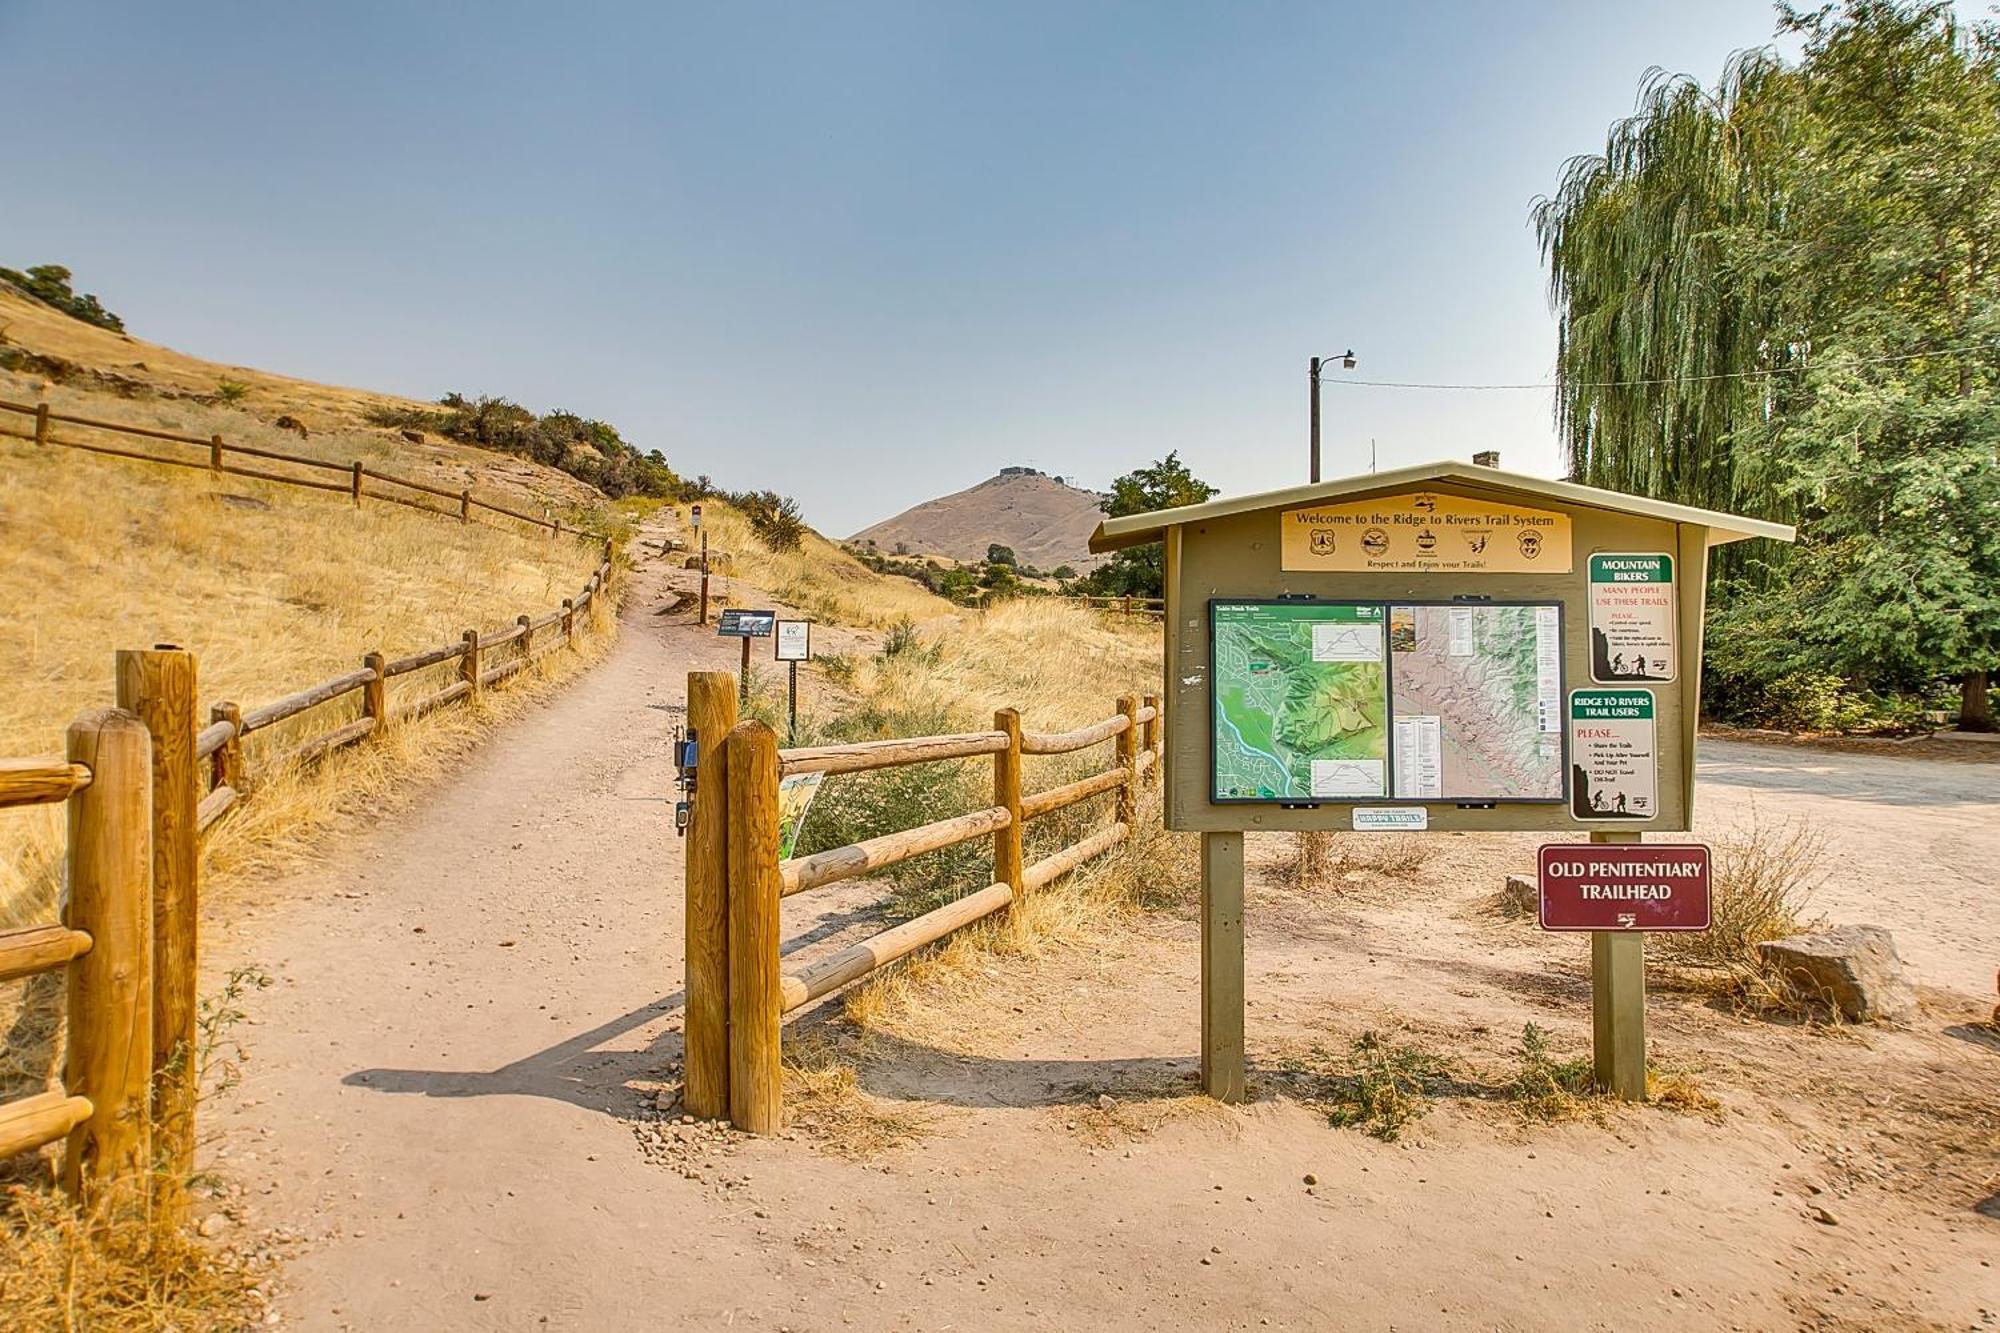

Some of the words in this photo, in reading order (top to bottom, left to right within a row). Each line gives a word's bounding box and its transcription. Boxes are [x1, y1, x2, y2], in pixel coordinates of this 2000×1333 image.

[1296, 513, 1352, 525] Welcome
[1355, 514, 1367, 525] to
[1371, 513, 1390, 525] the
[1393, 513, 1426, 527] Ridge
[1430, 515, 1441, 525] to
[1446, 514, 1480, 525] Rivers
[1484, 514, 1510, 525] Trail
[1513, 514, 1554, 528] System
[1367, 560, 1398, 570] Respect
[1401, 560, 1416, 568] and
[1418, 561, 1440, 569] Enjoy
[1602, 560, 1660, 570] MOUNTAIN
[1614, 572, 1649, 581] BIKERS
[1602, 586, 1628, 594] MANY
[1630, 586, 1660, 594] PEOPLE
[1596, 598, 1612, 606] USE
[1614, 598, 1638, 606] THESE
[1641, 598, 1669, 606] TRAILS
[1574, 697, 1604, 706] RIDGE
[1604, 697, 1617, 706] TO
[1618, 697, 1650, 706] RIVERS
[1585, 708, 1610, 716] TRAIL
[1611, 708, 1640, 716] USERS
[1548, 861, 1585, 878] OLD
[1589, 861, 1703, 878] PENITENTIARY
[1579, 884, 1672, 900] TRAILHEAD
